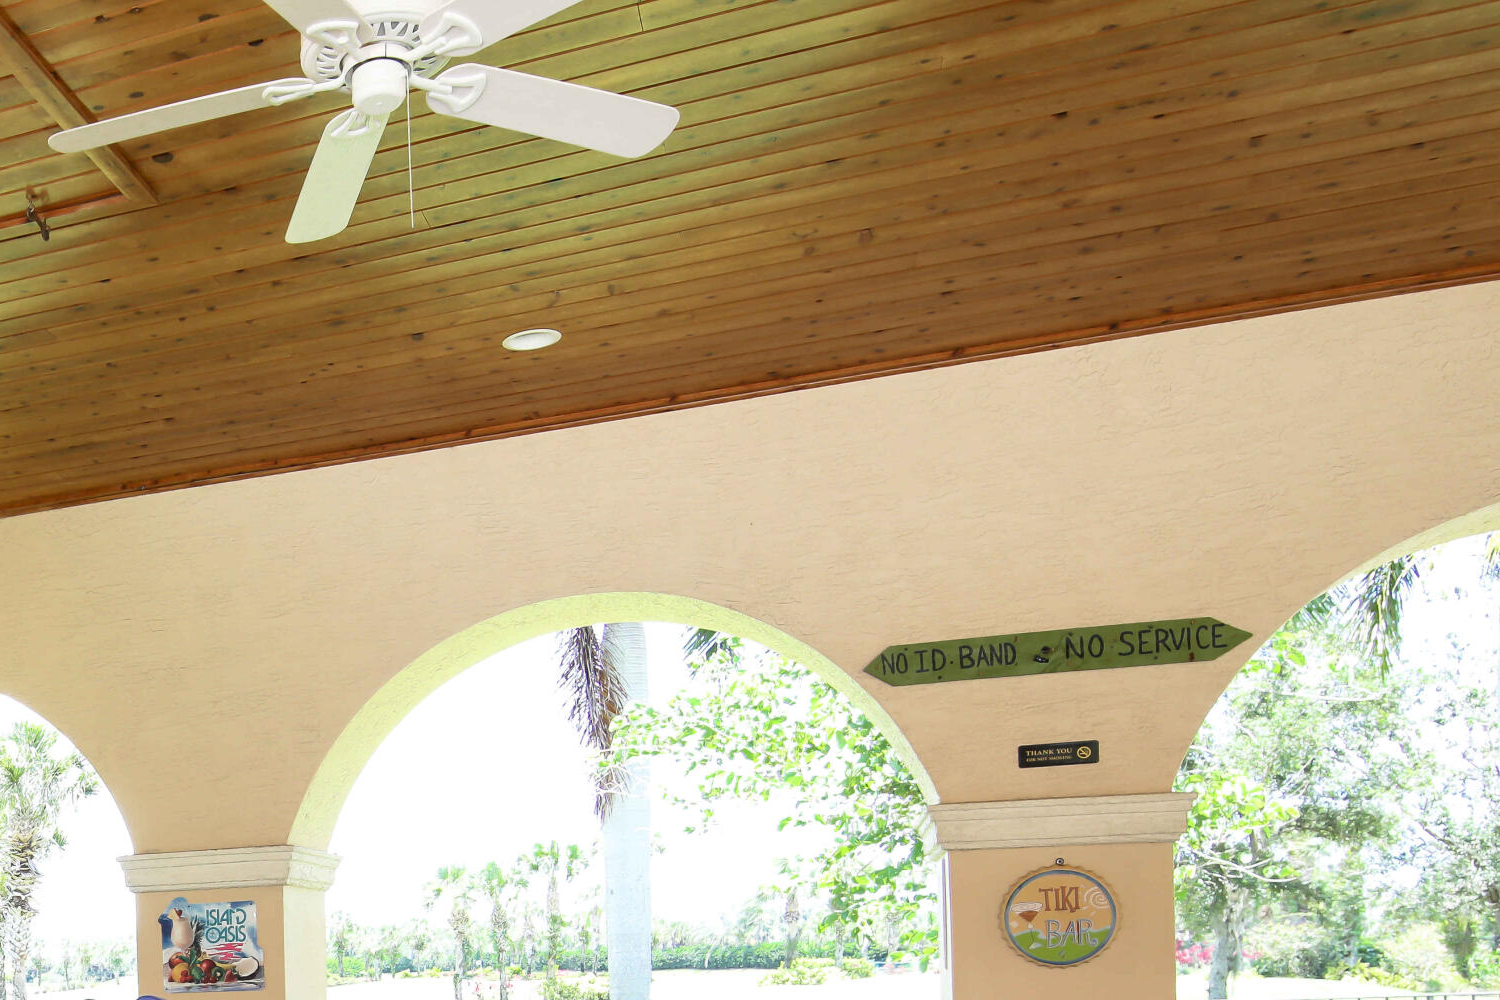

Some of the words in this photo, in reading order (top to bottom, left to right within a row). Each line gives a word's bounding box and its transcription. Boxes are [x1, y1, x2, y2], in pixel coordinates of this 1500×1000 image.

[880, 652, 909, 676] NO
[959, 642, 1018, 669] BAND
[1065, 633, 1105, 660] NO
[1118, 623, 1228, 656] SERVICE
[1025, 748, 1054, 757] THANK
[1056, 747, 1073, 755] YOU
[1038, 886, 1081, 913] TIKI
[206, 908, 246, 926] ISLAND
[205, 925, 246, 943] OASIS
[1046, 918, 1099, 949] BAR
